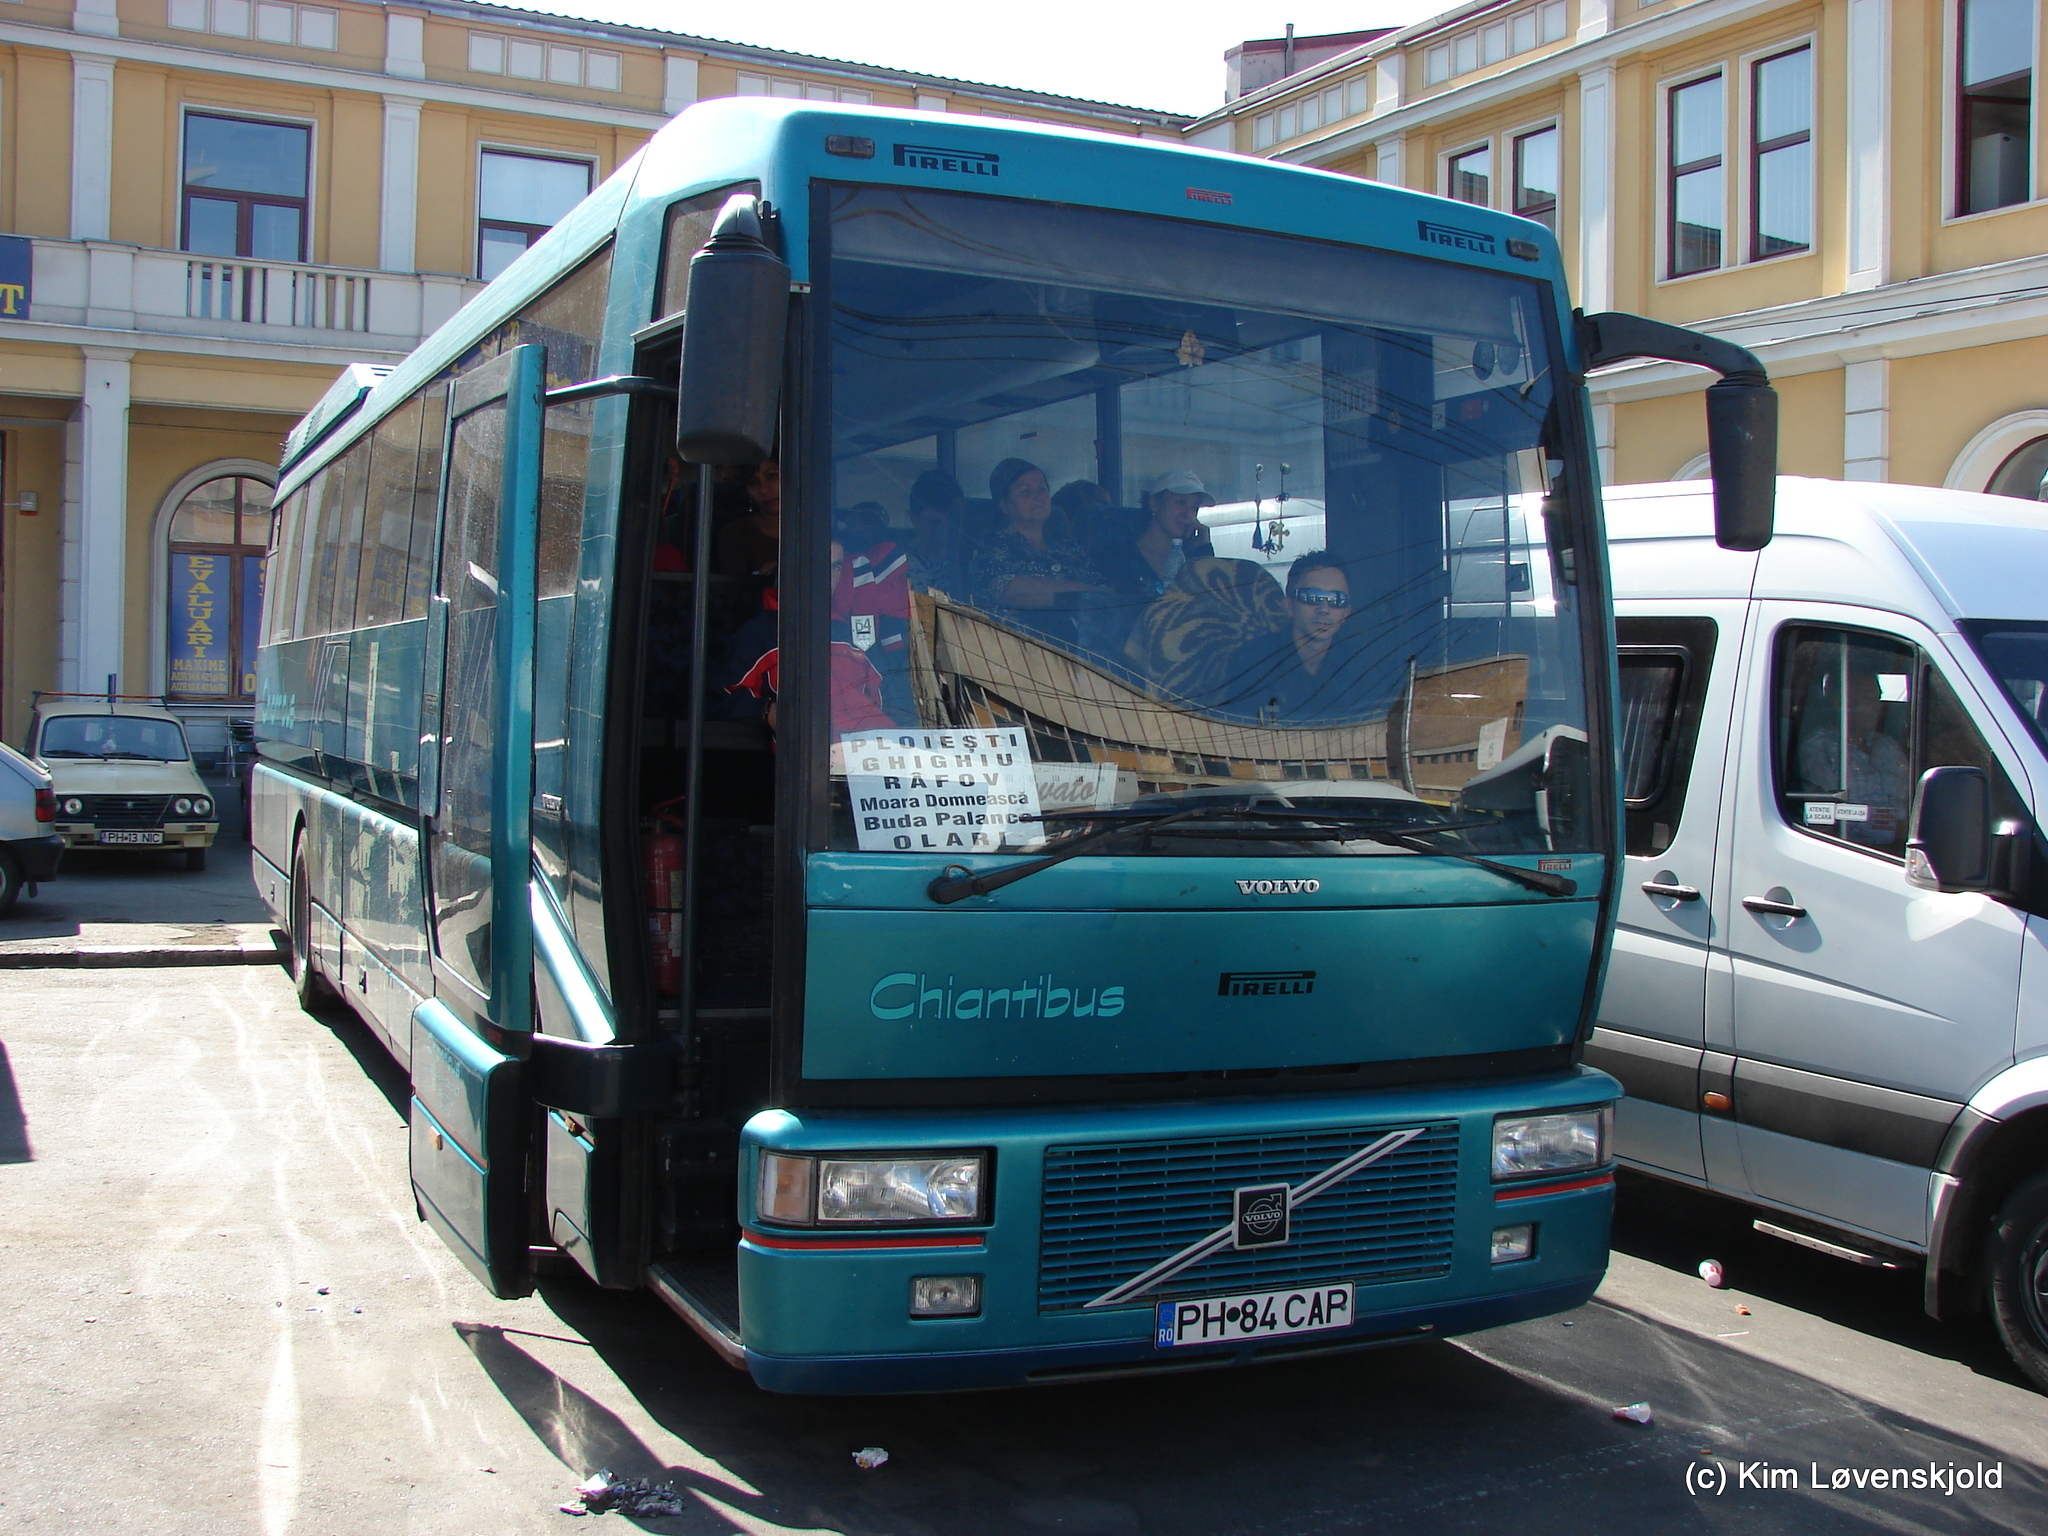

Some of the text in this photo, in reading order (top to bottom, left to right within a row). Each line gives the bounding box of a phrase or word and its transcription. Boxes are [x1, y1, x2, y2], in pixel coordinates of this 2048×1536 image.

[892, 143, 999, 176] PIRELLI
[1186, 187, 1232, 205] PIRELLI
[1417, 220, 1496, 256] PIRELLI
[187, 556, 214, 658] EVALUARI
[173, 659, 226, 671] MAXIME
[862, 753, 1013, 772] GHIGHIU
[884, 772, 999, 790] RÂFOV
[860, 791, 1029, 812] Moara Domnească
[864, 813, 928, 831] Buda
[893, 832, 1007, 850] OLARI
[1537, 858, 1572, 870] PIRELLI
[1235, 879, 1320, 895] VOLVO
[1218, 970, 1317, 996] PIRELLI
[870, 971, 1125, 1020] Chiantibus
[1244, 1211, 1281, 1222] VOLVO
[1158, 1328, 1173, 1342] RO
